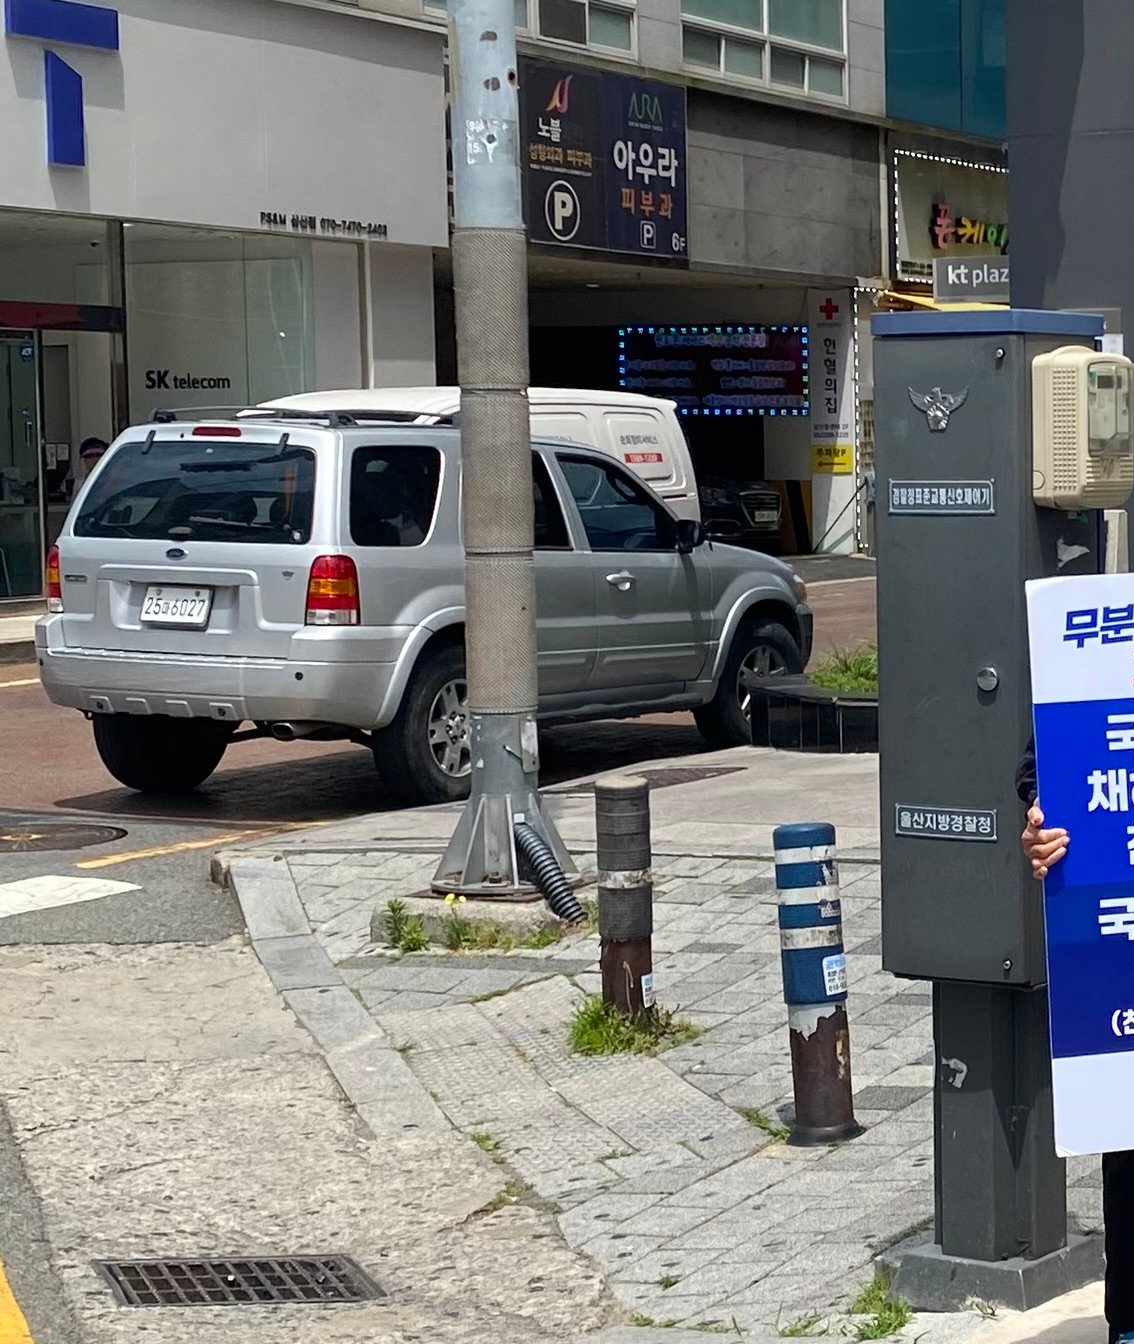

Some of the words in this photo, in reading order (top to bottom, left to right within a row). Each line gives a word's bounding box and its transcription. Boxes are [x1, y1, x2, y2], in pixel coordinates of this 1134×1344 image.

[537, 116, 562, 143] 노블
[613, 140, 678, 187] 아우라
[553, 190, 574, 230] P
[620, 187, 673, 220] 피부과
[671, 232, 686, 252] 6F
[947, 264, 969, 285] kt
[145, 370, 170, 390] SK
[173, 373, 231, 390] telecom
[900, 811, 992, 834] 울산지방경찰청
